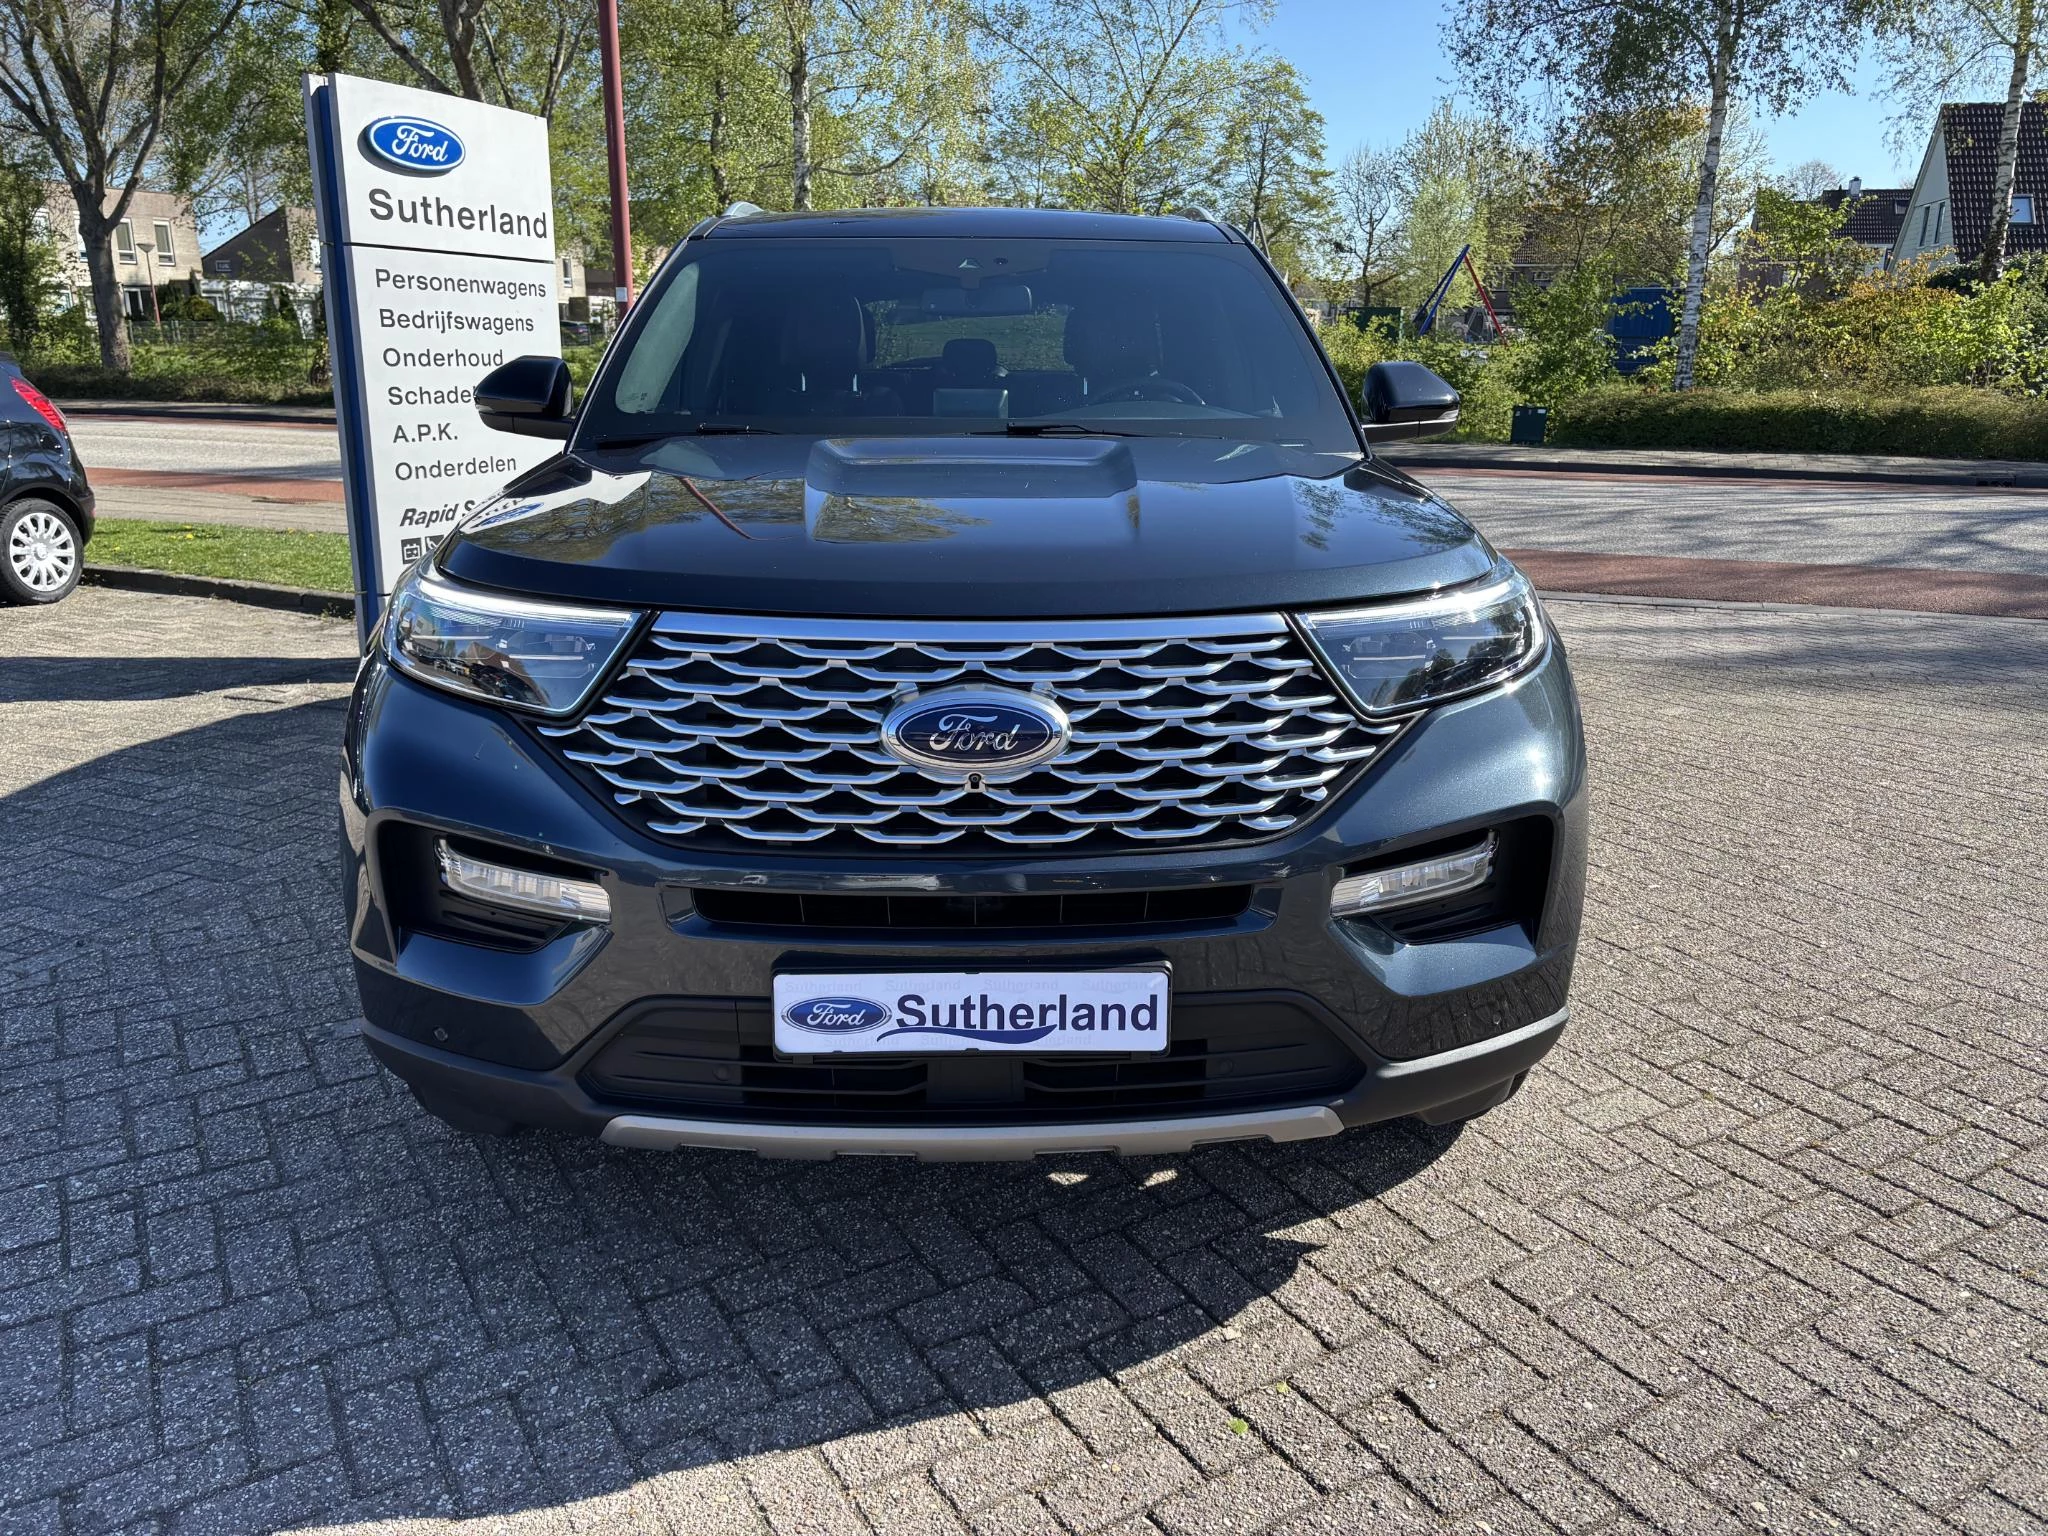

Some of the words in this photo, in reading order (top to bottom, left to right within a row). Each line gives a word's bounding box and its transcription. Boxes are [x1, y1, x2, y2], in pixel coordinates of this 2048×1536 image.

[391, 125, 449, 163] Ford
[368, 188, 548, 239] Sutherland
[375, 268, 547, 300] Personenwagens
[379, 308, 535, 335] Bedrijfswagens
[382, 347, 504, 368] Onderhoud
[387, 386, 477, 406] Schade
[392, 422, 459, 443] A.P.K.
[394, 456, 517, 480] Onderdelen
[399, 503, 459, 529] Rapid
[929, 713, 1021, 751] Ford
[805, 1003, 867, 1027] Ford
[895, 993, 1159, 1032] Sutherland
